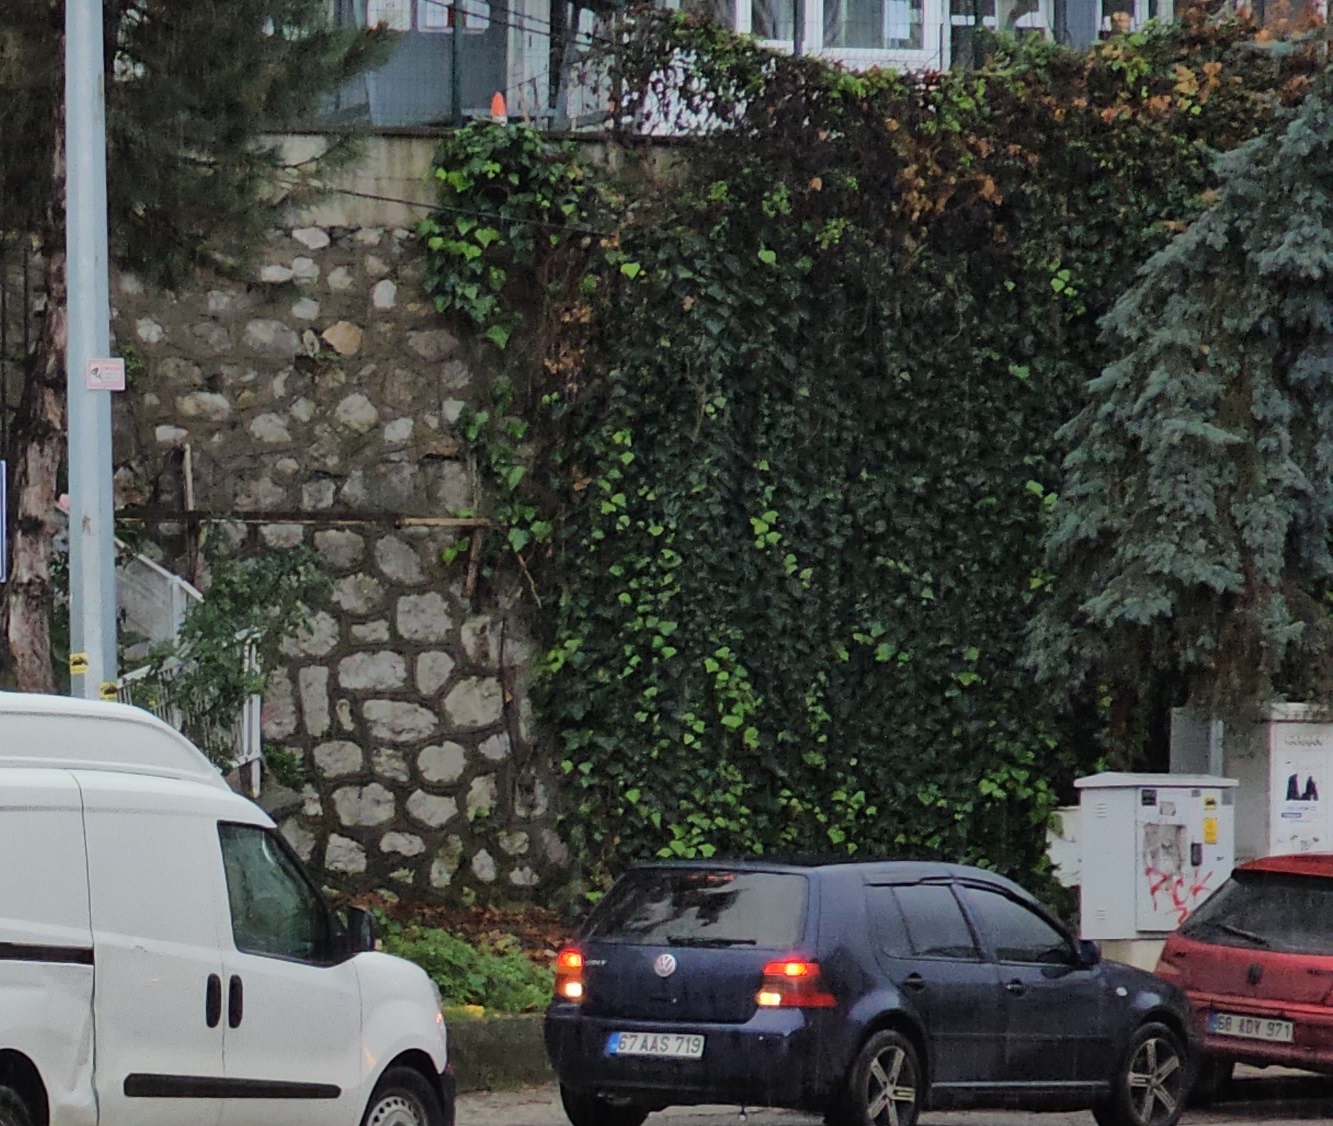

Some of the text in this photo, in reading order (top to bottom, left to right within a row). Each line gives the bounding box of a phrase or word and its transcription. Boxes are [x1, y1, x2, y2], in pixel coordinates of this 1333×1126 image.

[618, 1034, 701, 1054] 67 AAS 719
